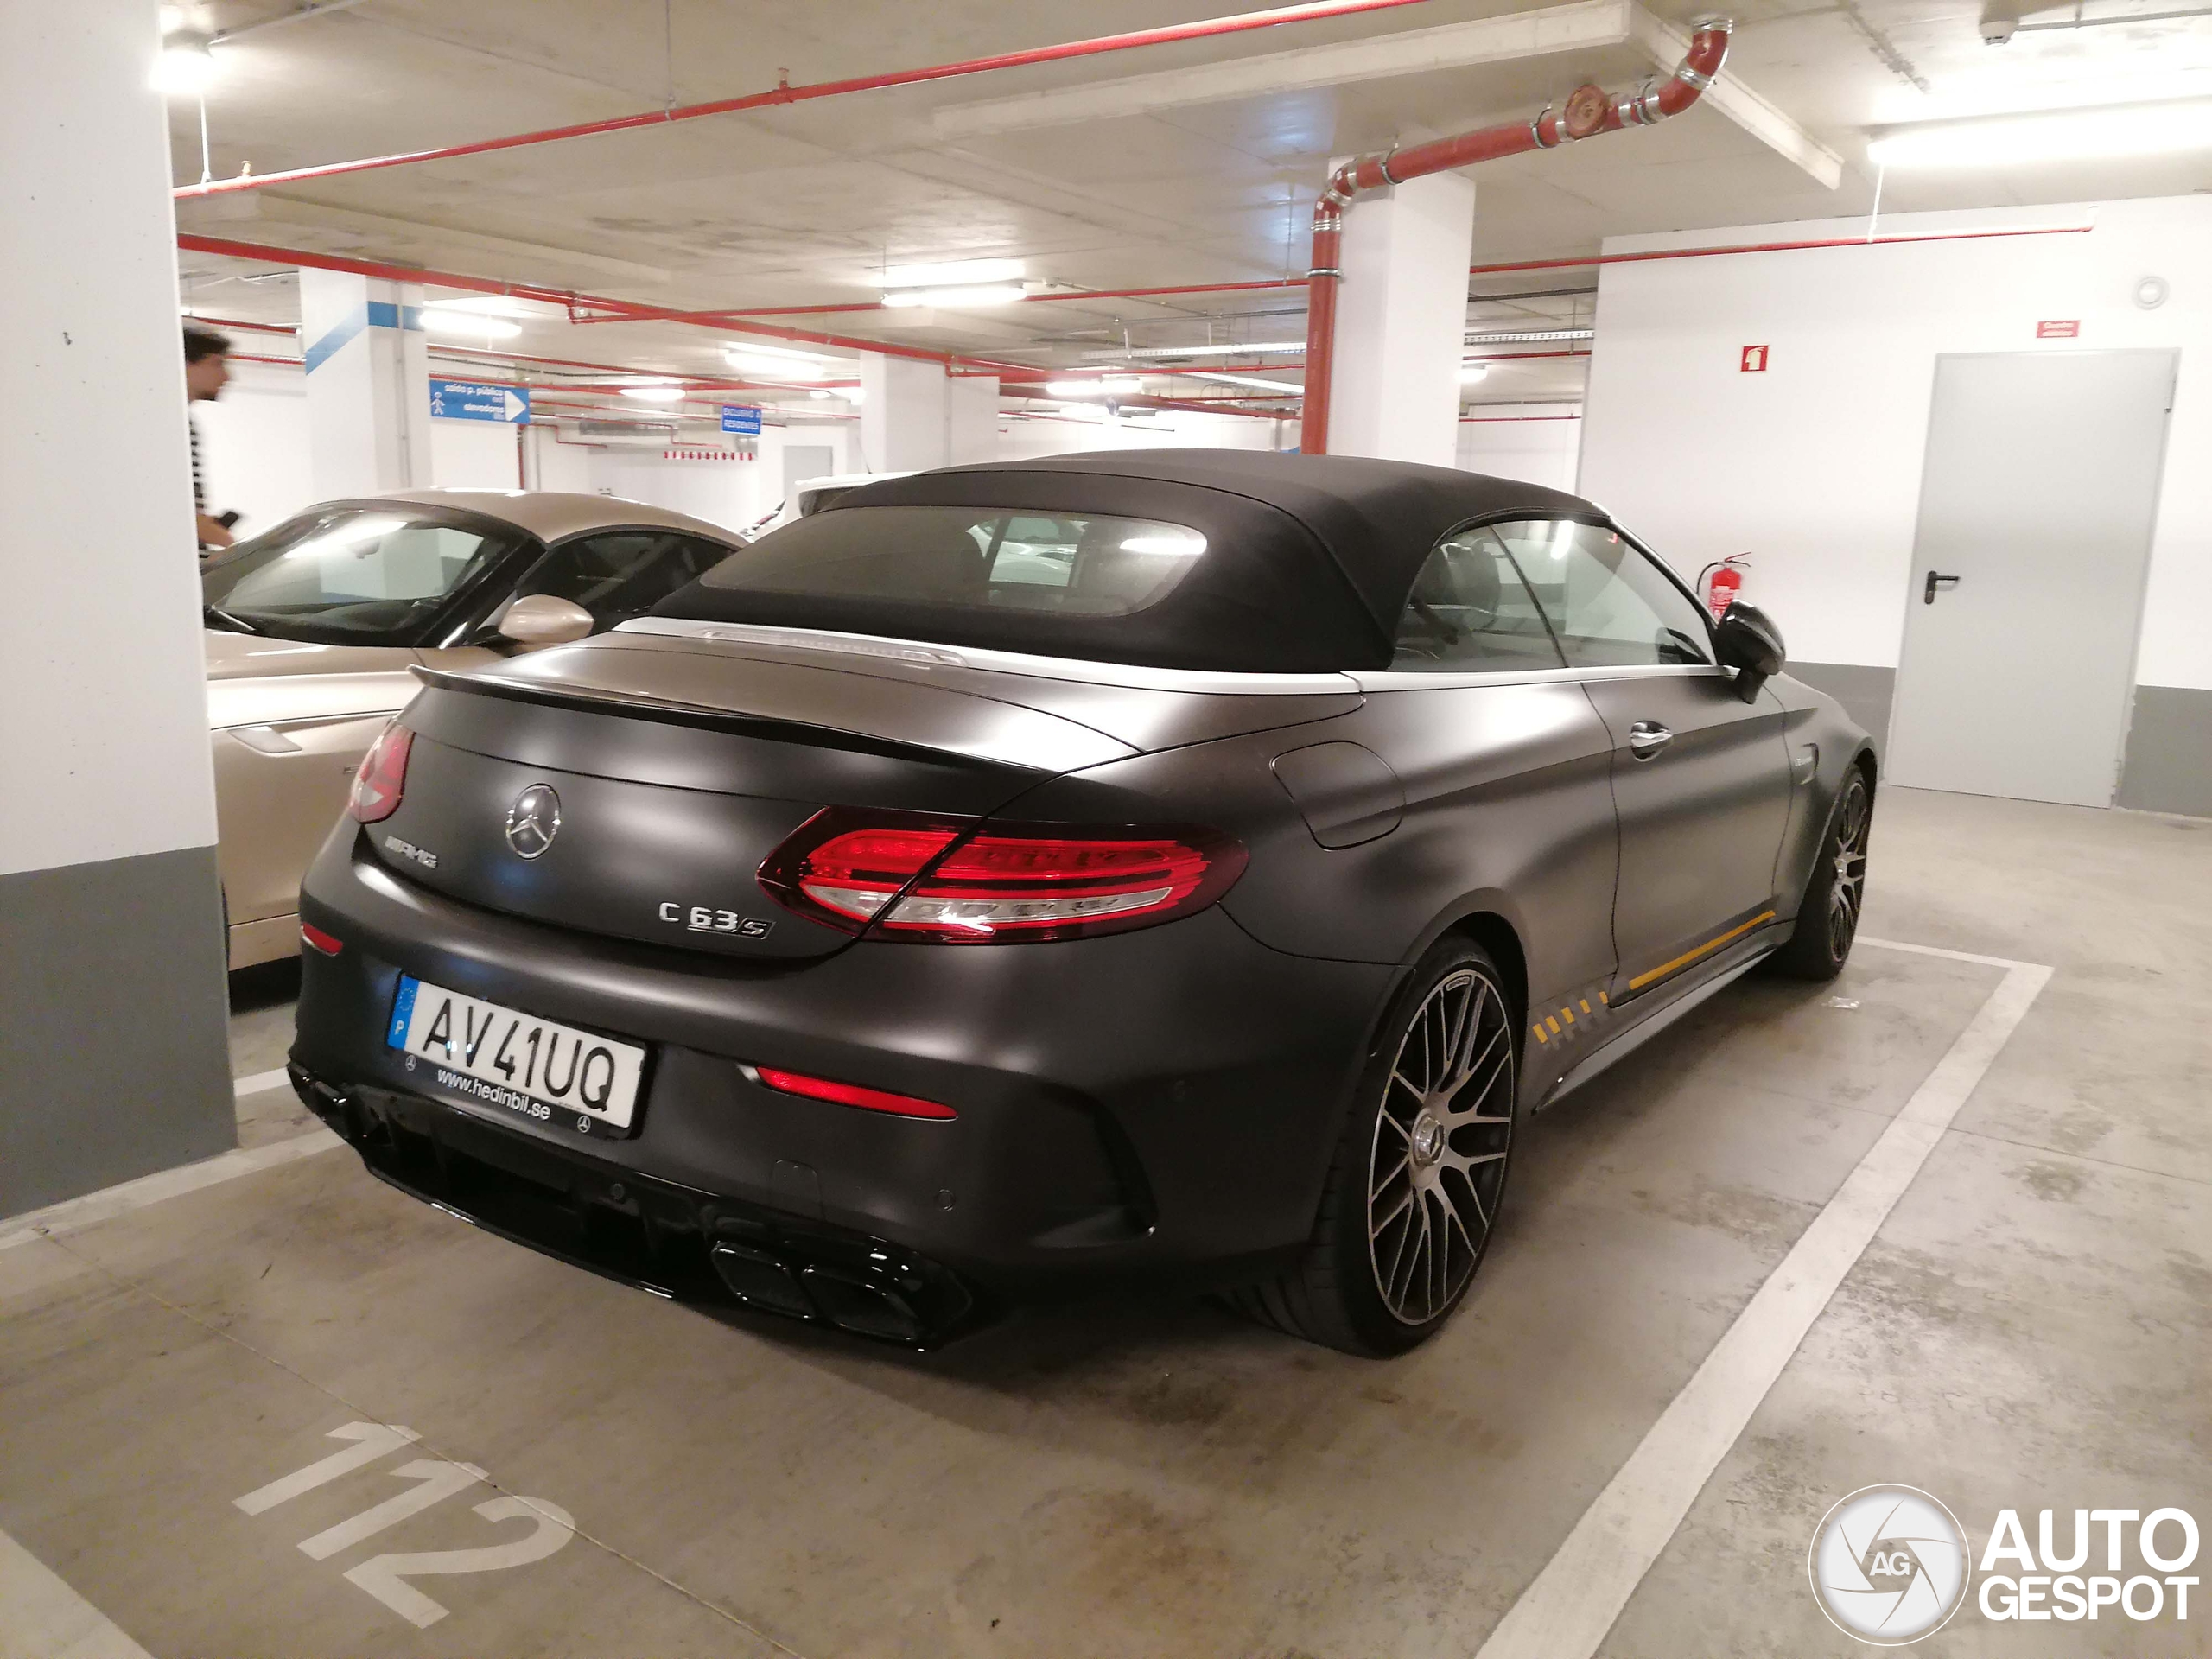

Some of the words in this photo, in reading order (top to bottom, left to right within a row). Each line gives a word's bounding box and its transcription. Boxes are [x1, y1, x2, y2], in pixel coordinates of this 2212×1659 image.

[658, 901, 681, 922] C
[394, 1020, 405, 1035] P
[436, 1068, 551, 1122] www.hedinbil.se
[231, 1421, 576, 1630] 112
